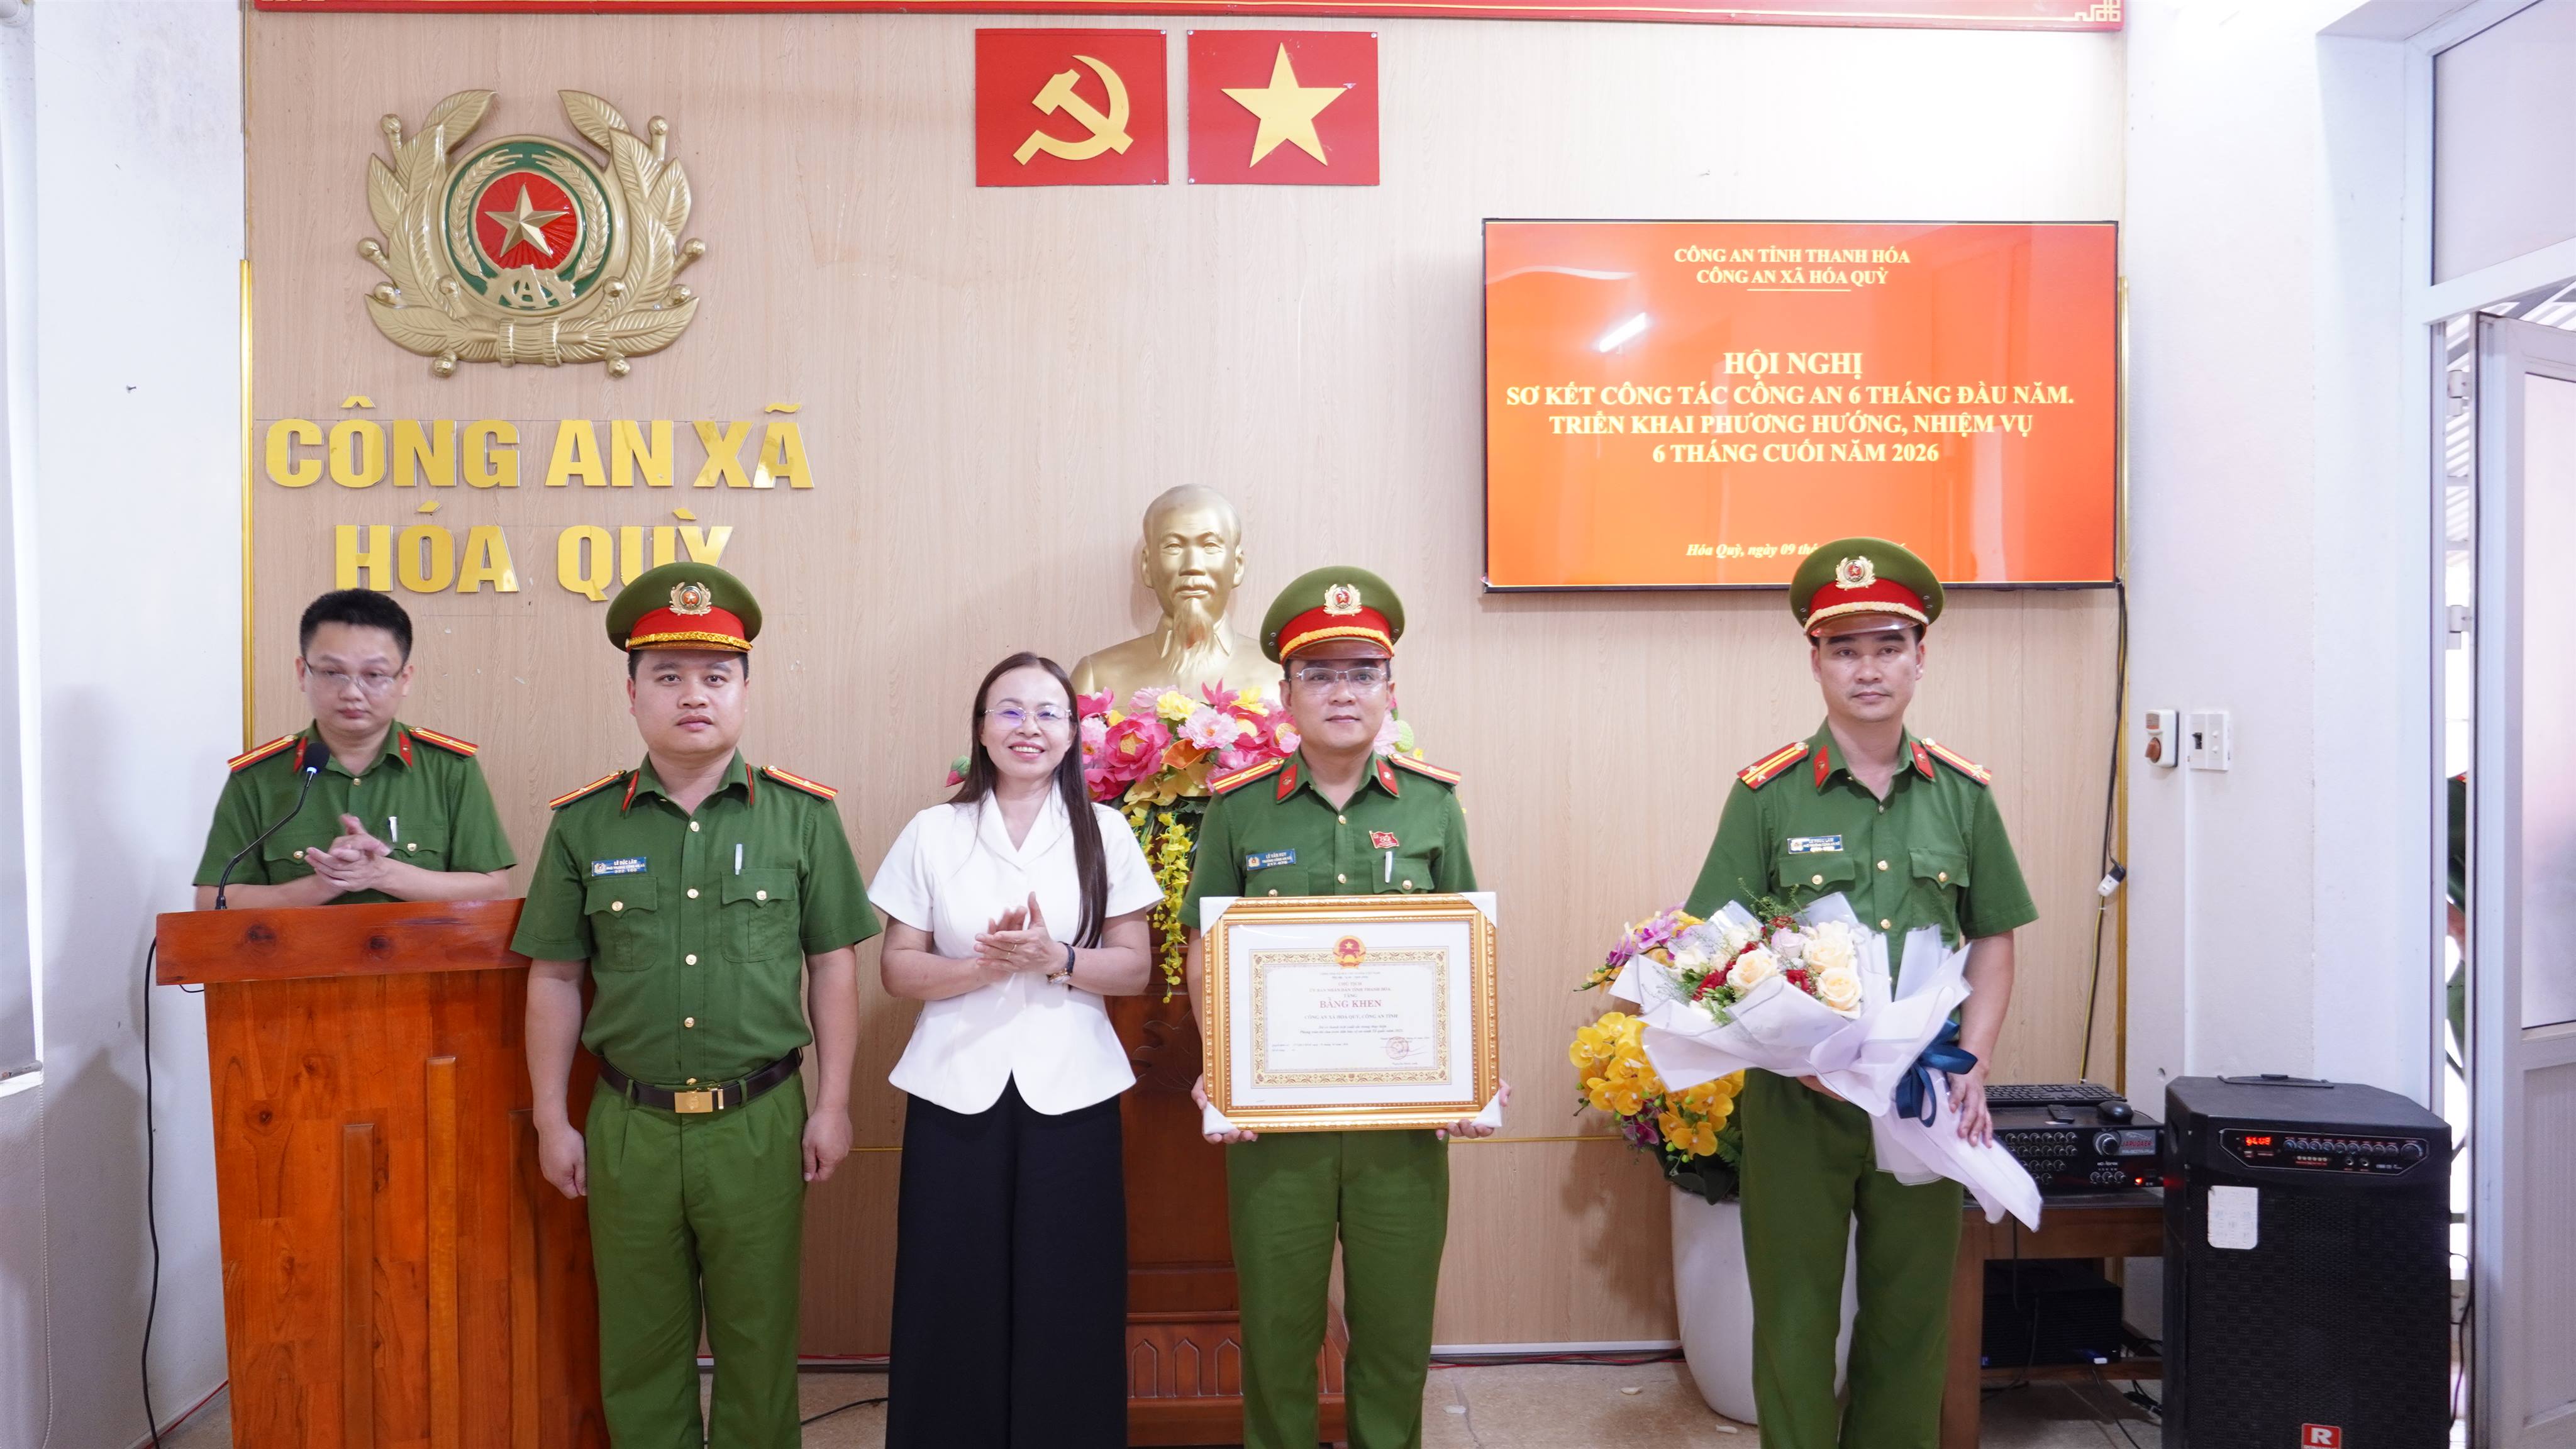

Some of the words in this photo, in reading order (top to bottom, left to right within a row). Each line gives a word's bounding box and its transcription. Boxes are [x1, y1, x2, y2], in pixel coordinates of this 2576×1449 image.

[1674, 245, 1726, 262] CÔNG
[1729, 248, 1754, 263] AN
[1757, 245, 1802, 263] TỈNH
[1805, 249, 1868, 263] THANH
[1872, 246, 1911, 264] HÓA
[1696, 265, 1748, 284] CÔNG
[1751, 270, 1776, 284] AN
[1780, 267, 1806, 284] XÃ
[1809, 267, 1848, 284] HÓA
[1850, 267, 1889, 287] QUỲ
[1723, 348, 1780, 380] HỘI
[1786, 352, 1863, 380] NGHỊ
[1506, 385, 1540, 406] SƠ
[1544, 381, 1596, 405] KẾT
[1600, 381, 1673, 405] CÔNG
[1677, 381, 1728, 405] TÁC
[1733, 381, 1805, 405] CÔNG
[1809, 386, 1843, 404] AN
[1848, 386, 1862, 404] 6
[1865, 380, 1952, 404] THÁNG
[1956, 381, 2007, 404] ĐẦU
[2012, 381, 2074, 404] NĂM.
[1548, 411, 1625, 434] TRIỂN
[1630, 415, 1694, 434] KHAI
[1700, 413, 1806, 434] PHƯƠNG
[1811, 410, 1908, 436] HƯỚNG,
[1913, 412, 1996, 438] NHIỆM
[1999, 414, 2033, 438] VỤ
[266, 396, 520, 487] CÔNG
[545, 419, 673, 487] AN
[692, 402, 814, 488] XÃ
[1652, 444, 1666, 463] 6
[1670, 438, 1758, 463] THÁNG
[1763, 438, 1824, 463] CUỐI
[1830, 439, 1886, 462] NĂM
[1891, 443, 1940, 462] 2026
[335, 501, 520, 593] HÓA
[557, 508, 733, 601] QUỲ
[1685, 543, 1713, 556] Hóa
[1716, 543, 1745, 559] Quỳ,
[1747, 544, 1778, 558] ngày
[1780, 543, 1796, 555] 09
[1797, 543, 1818, 555] thá
[1319, 997, 1349, 1009] BẰNG
[1352, 999, 1382, 1008] KHEN
[2311, 1427, 2333, 1445] R
